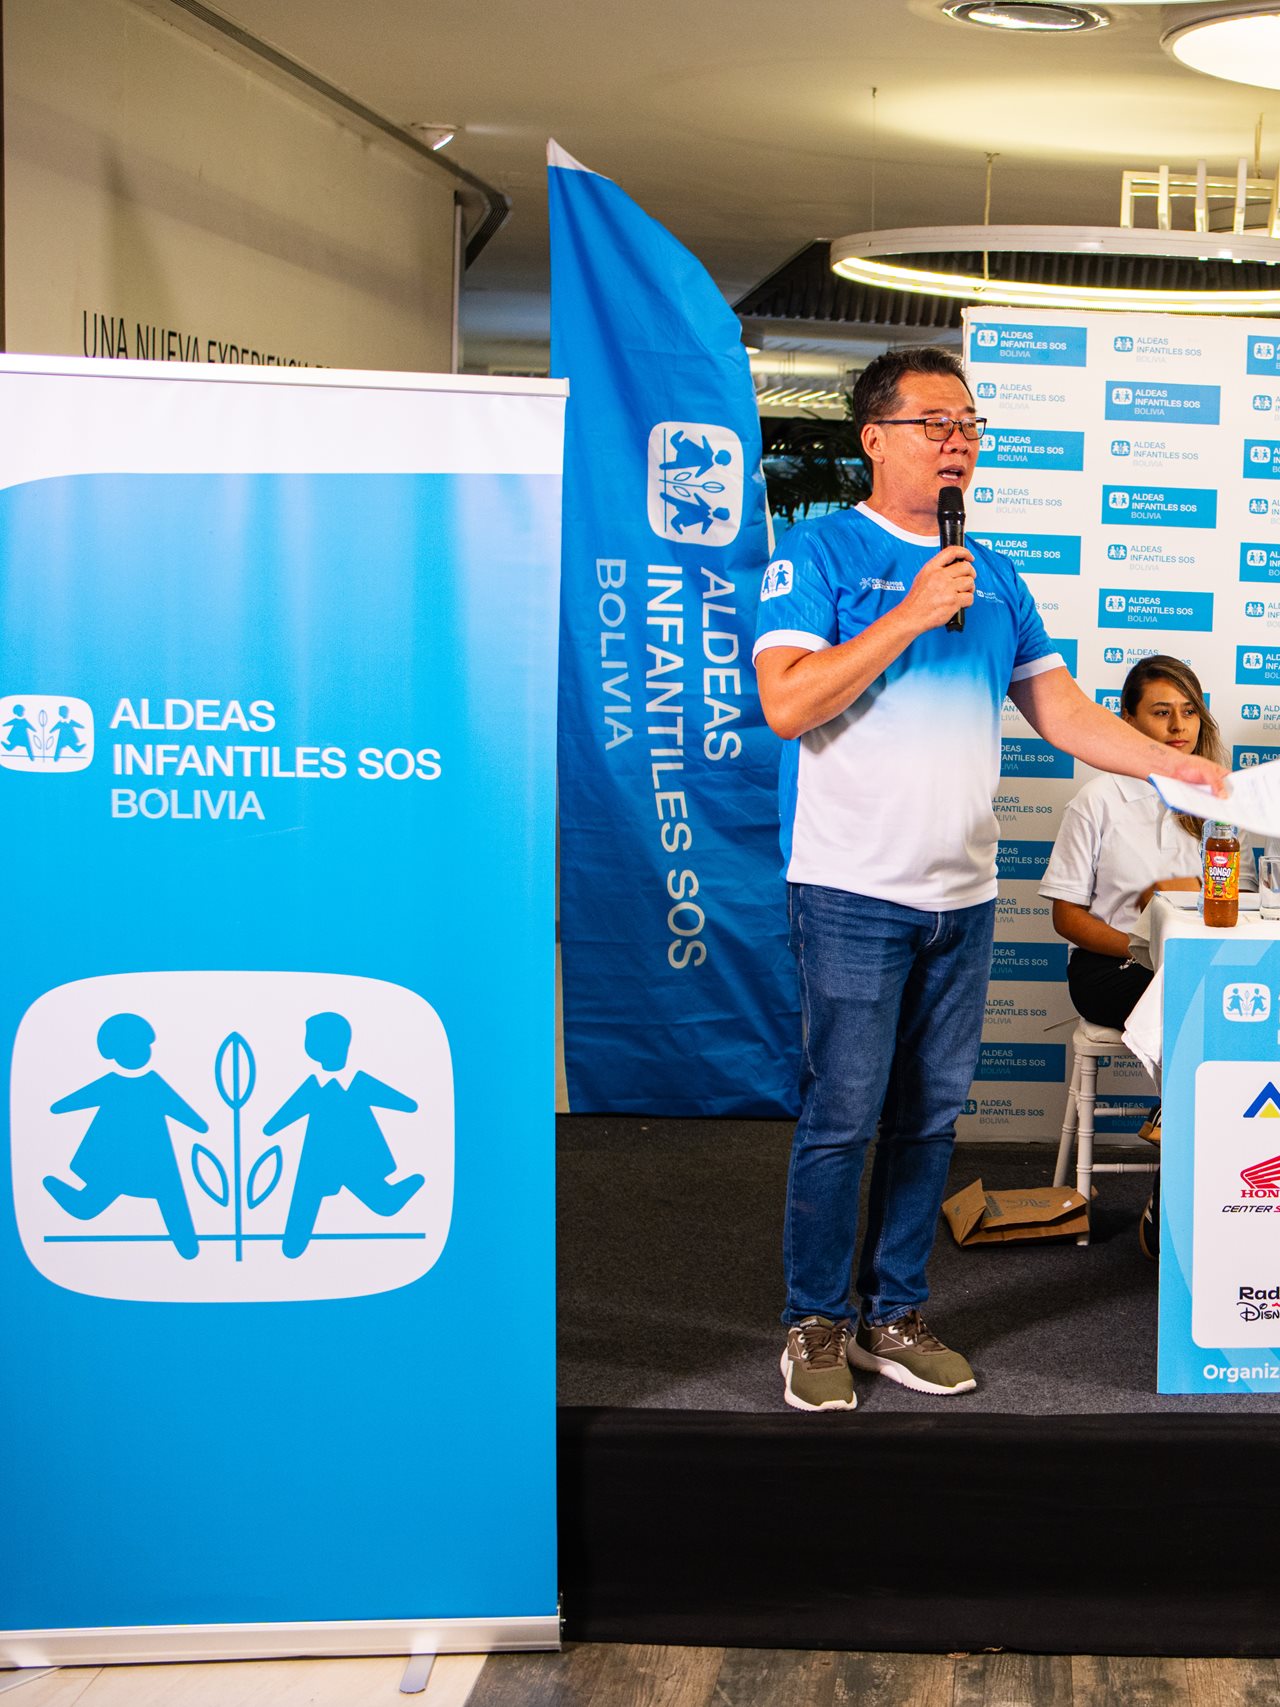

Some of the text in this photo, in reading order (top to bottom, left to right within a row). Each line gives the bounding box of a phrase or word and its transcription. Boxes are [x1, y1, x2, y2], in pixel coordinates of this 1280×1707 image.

[83, 310, 128, 360] UNA
[1000, 331, 1034, 340] ALDEAS
[1000, 340, 1067, 351] INFANTILES SOS
[999, 349, 1031, 358] BOLIVIA
[1134, 389, 1168, 398] ALDEAS
[1134, 398, 1201, 409] INFANTILES SOS
[1134, 407, 1165, 416] BOLIVIA
[1132, 493, 1165, 502] ALDEAS
[1132, 502, 1197, 512] INFANTILES SOS
[1130, 511, 1162, 520] BOLIVIA
[1128, 596, 1160, 605] ALDEAS
[1128, 605, 1194, 615] INFANTILES SOS
[1127, 615, 1158, 623] BOLIVIA
[595, 558, 634, 751] BOLIVIA
[701, 566, 742, 761] ALDEAS
[110, 697, 275, 733] ALDEAS
[112, 745, 442, 781] INFANTILES SOS
[646, 564, 707, 969] INFANTILES SOS
[110, 789, 266, 821] BOLIVIA
[981, 1059, 1027, 1067] INFANTILES
[1222, 1205, 1273, 1213] CENTER
